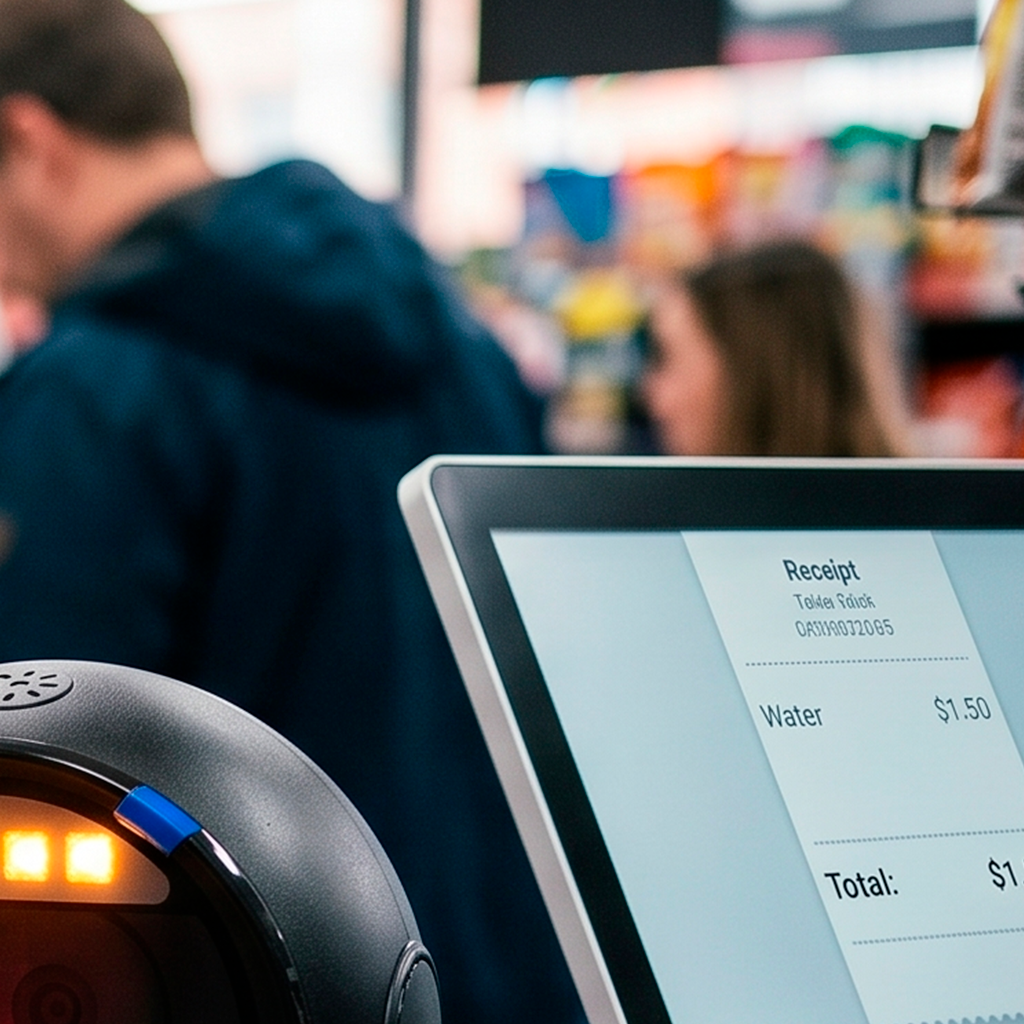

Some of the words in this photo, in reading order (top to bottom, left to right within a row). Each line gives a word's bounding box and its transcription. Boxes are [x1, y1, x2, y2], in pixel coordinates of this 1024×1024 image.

[782, 558, 861, 586] Receipt
[759, 704, 823, 728] Water
[933, 695, 992, 724] $1.50
[824, 867, 899, 900] Total:
[988, 857, 1024, 891] $1
